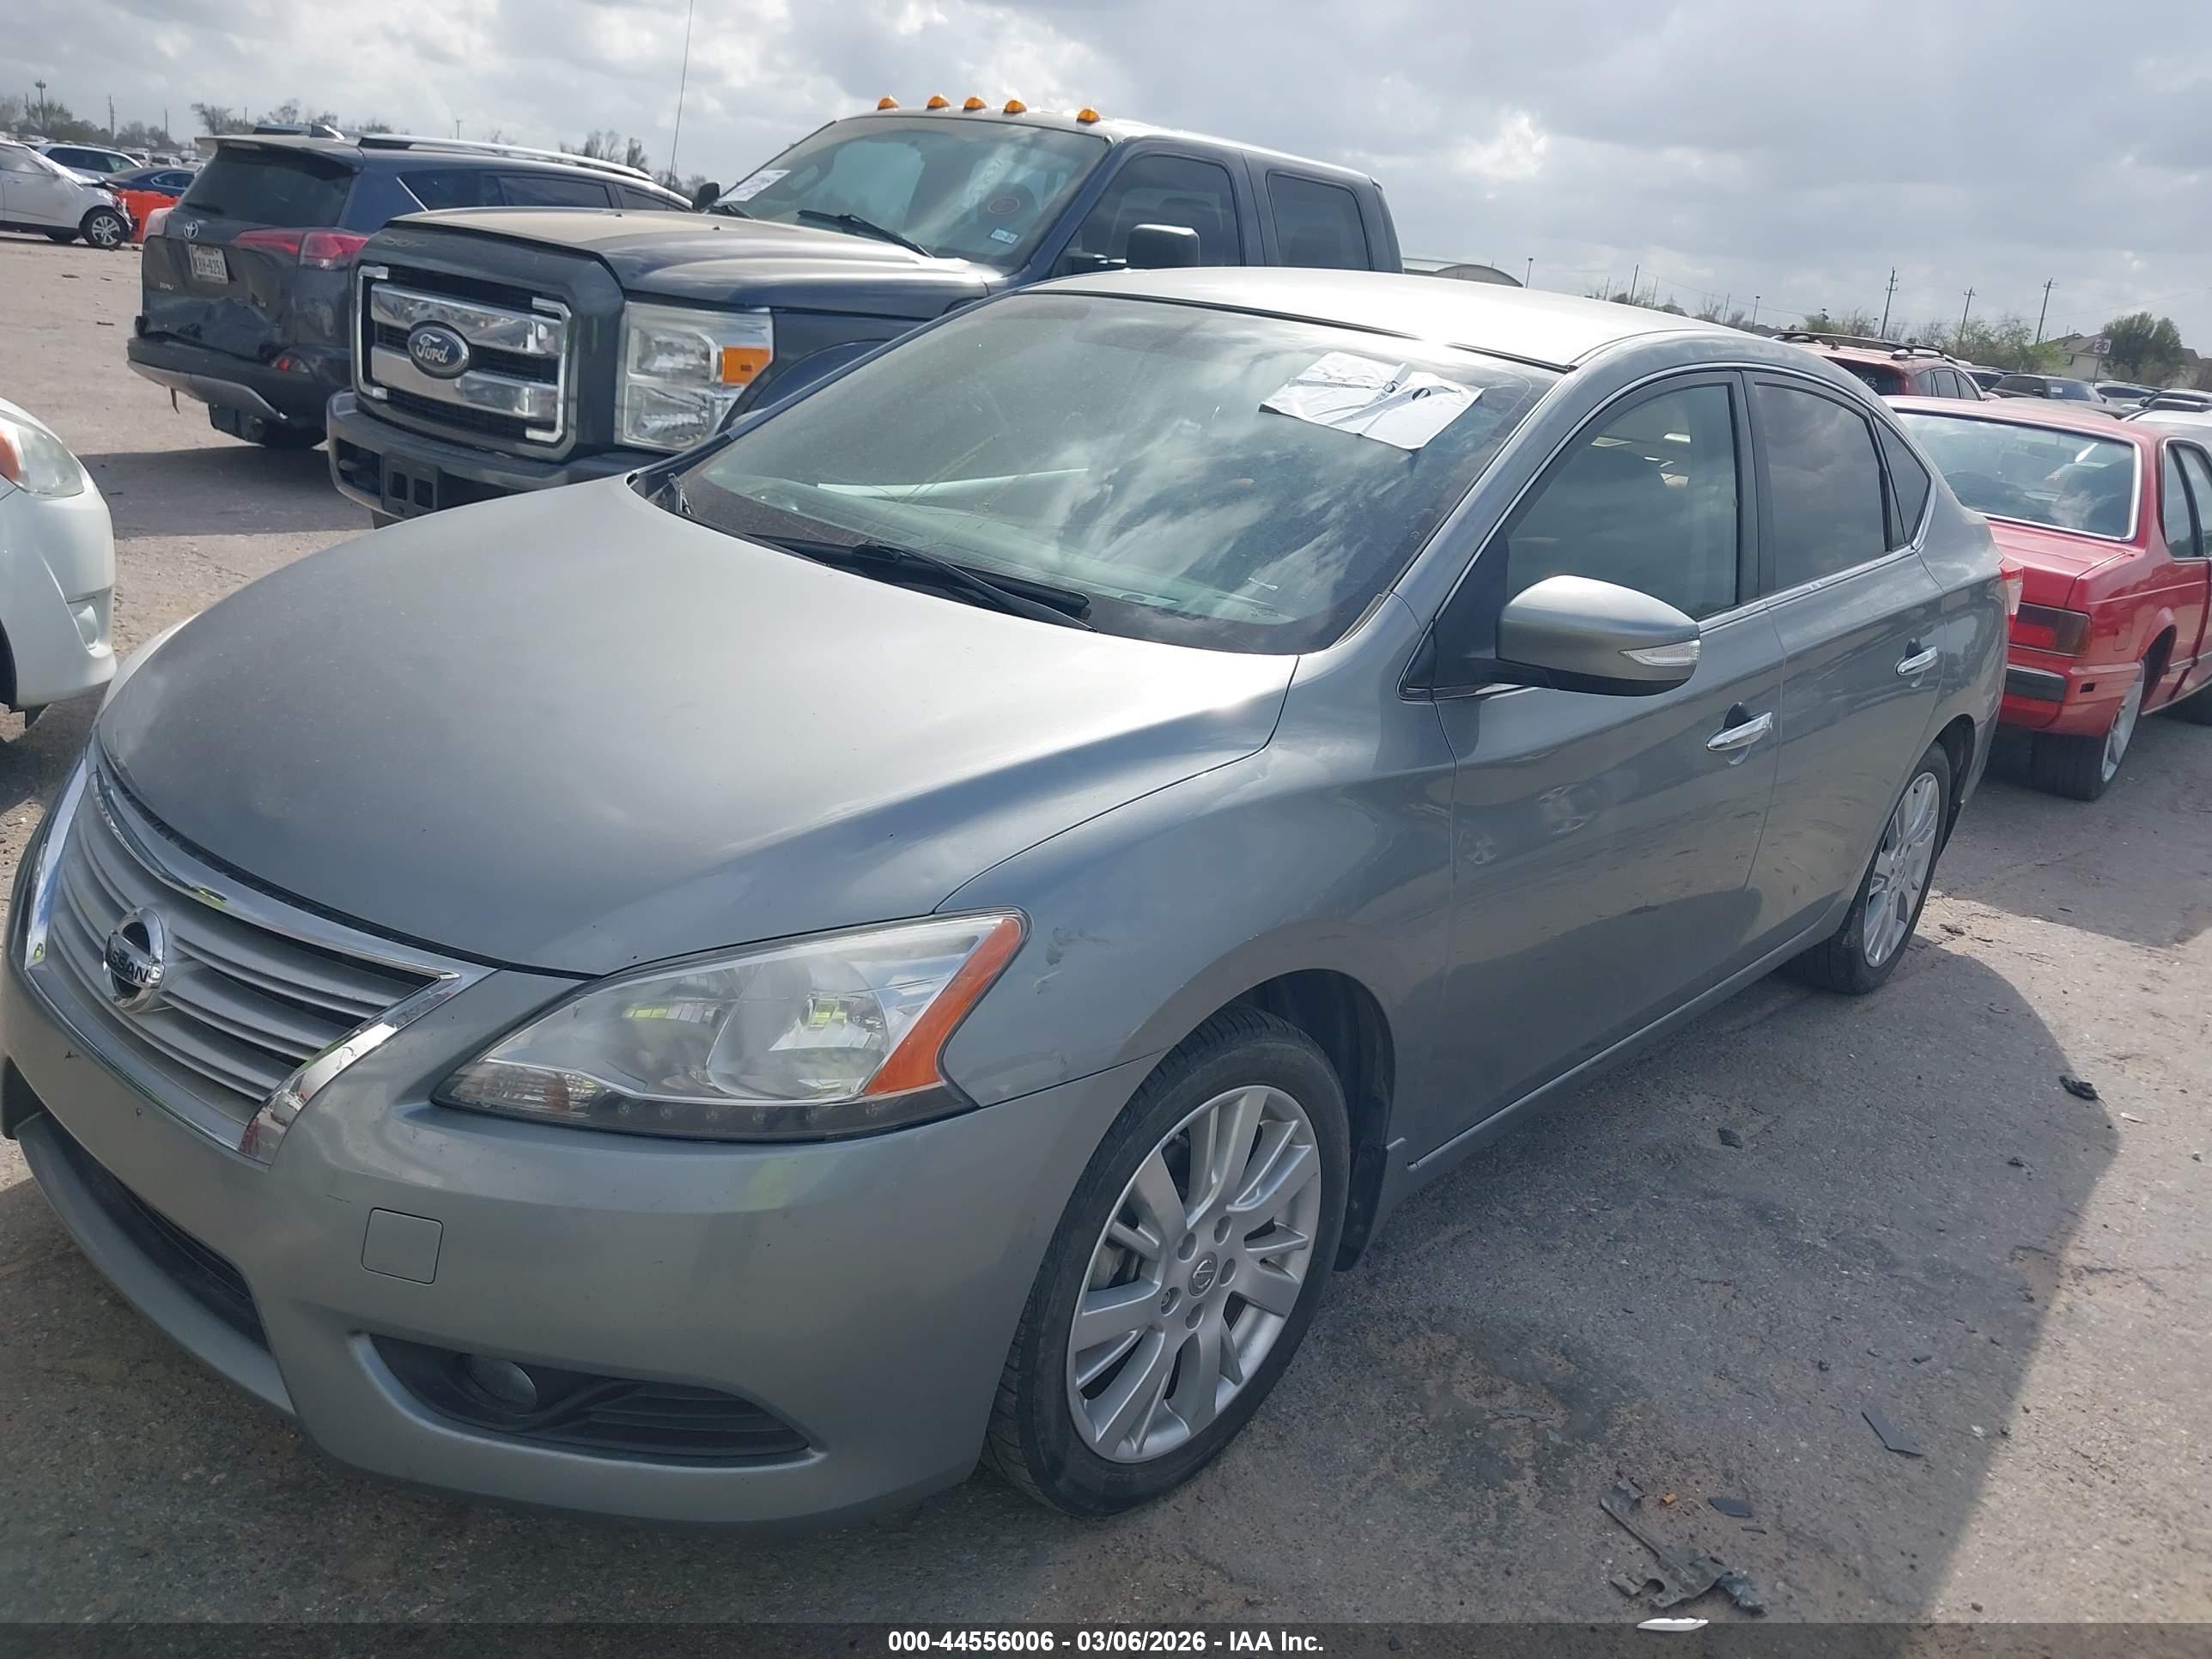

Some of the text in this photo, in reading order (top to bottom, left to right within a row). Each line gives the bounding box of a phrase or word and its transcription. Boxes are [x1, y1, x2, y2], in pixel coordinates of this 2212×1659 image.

[416, 333, 450, 363] Ford
[2095, 342, 2109, 351] 20
[107, 946, 149, 982] SSAN
